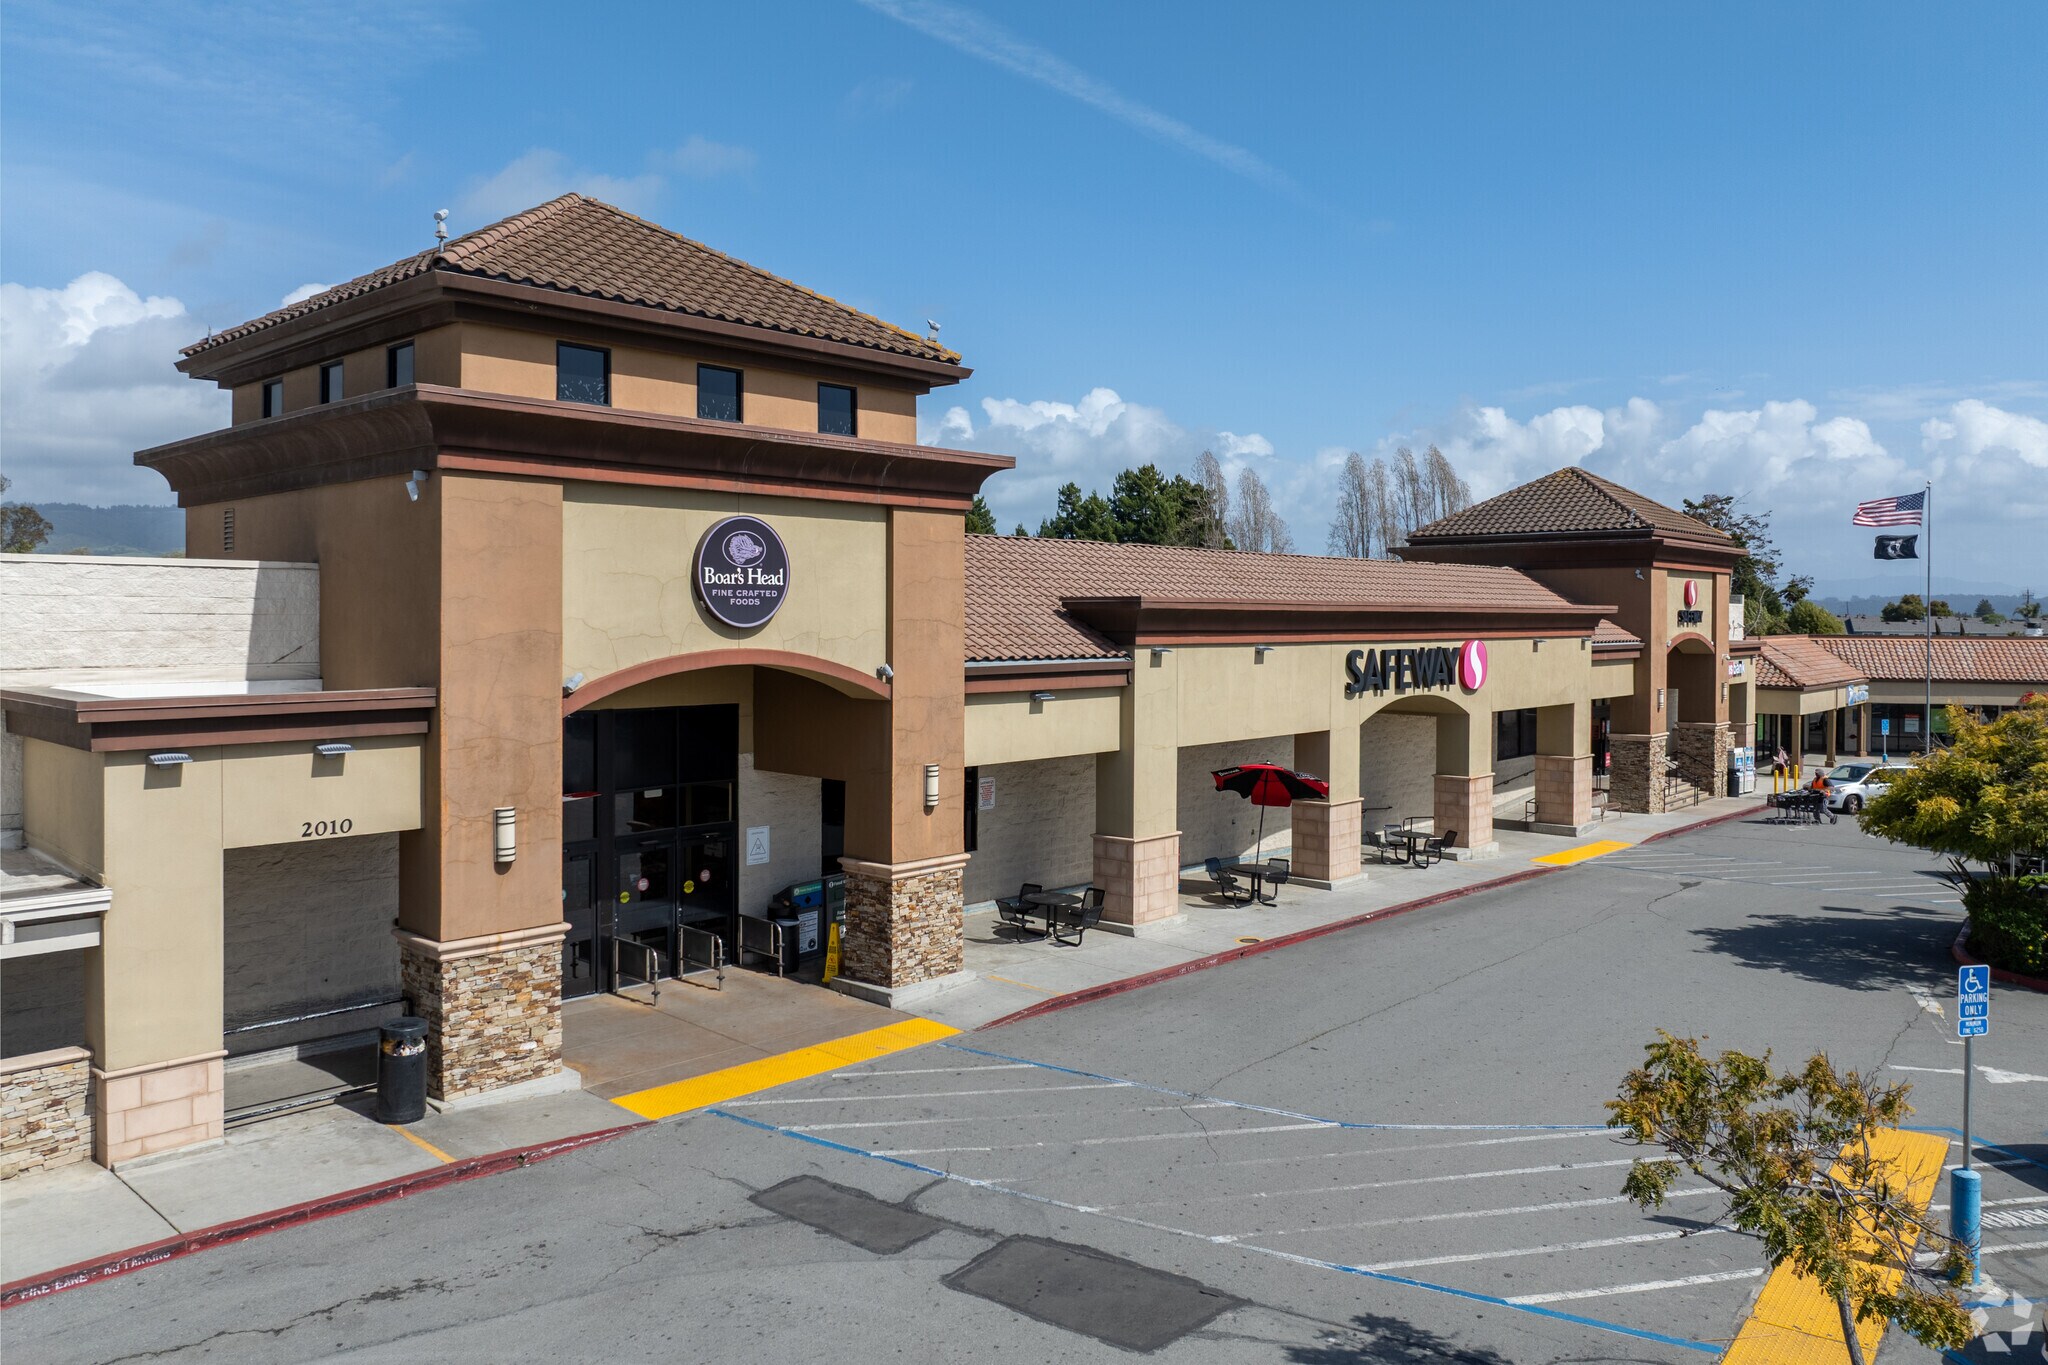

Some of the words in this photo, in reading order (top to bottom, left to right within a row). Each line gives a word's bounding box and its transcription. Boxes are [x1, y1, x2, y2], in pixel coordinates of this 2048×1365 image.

[703, 566, 745, 585] Boar's
[747, 567, 784, 586] Head
[712, 589, 734, 597] FINE
[735, 589, 778, 598] CRAFTED
[730, 598, 760, 606] FOODS
[1345, 647, 1462, 694] SAFEWAY
[301, 818, 353, 838] 2010
[1960, 993, 1988, 1004] PARKING
[1964, 1004, 1983, 1016] ONLY
